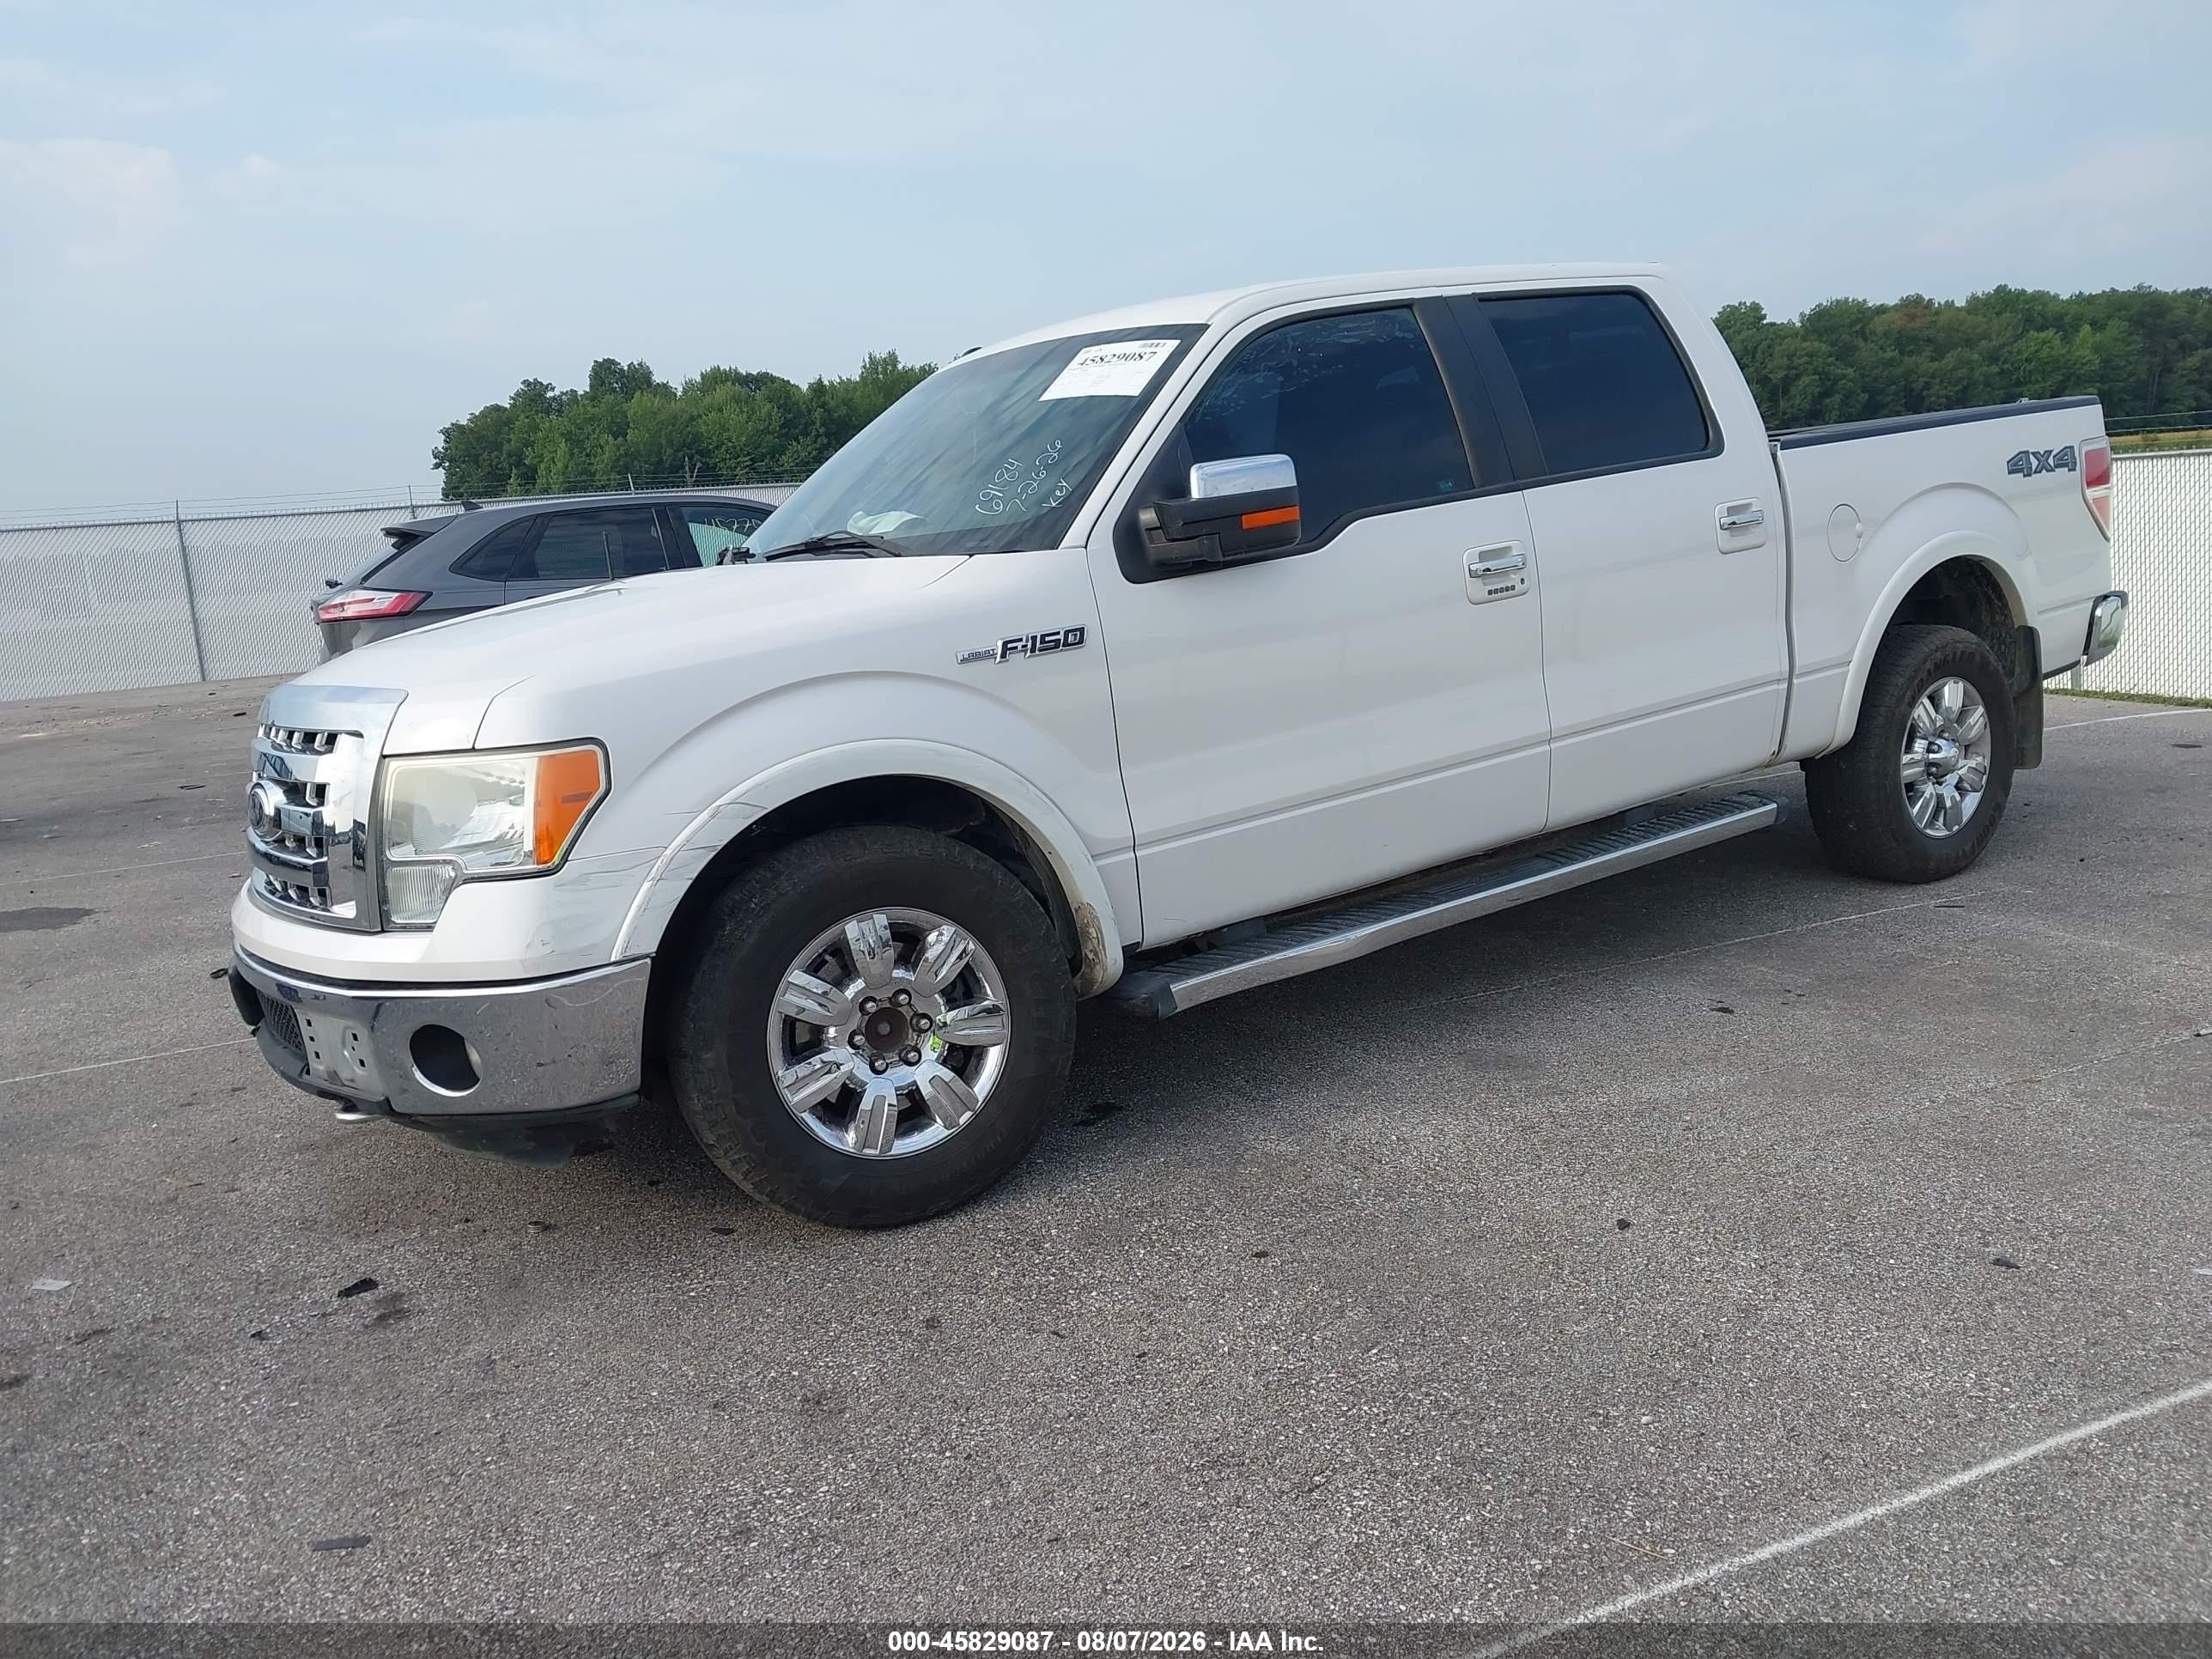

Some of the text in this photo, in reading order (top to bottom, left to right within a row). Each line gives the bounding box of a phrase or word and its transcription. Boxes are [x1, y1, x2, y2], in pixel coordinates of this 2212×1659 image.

[1078, 350, 1158, 367] 45829087
[975, 459, 1024, 515] 69184
[1006, 440, 1063, 512] 7-26-26
[960, 624, 1087, 664] LARIAT F-150
